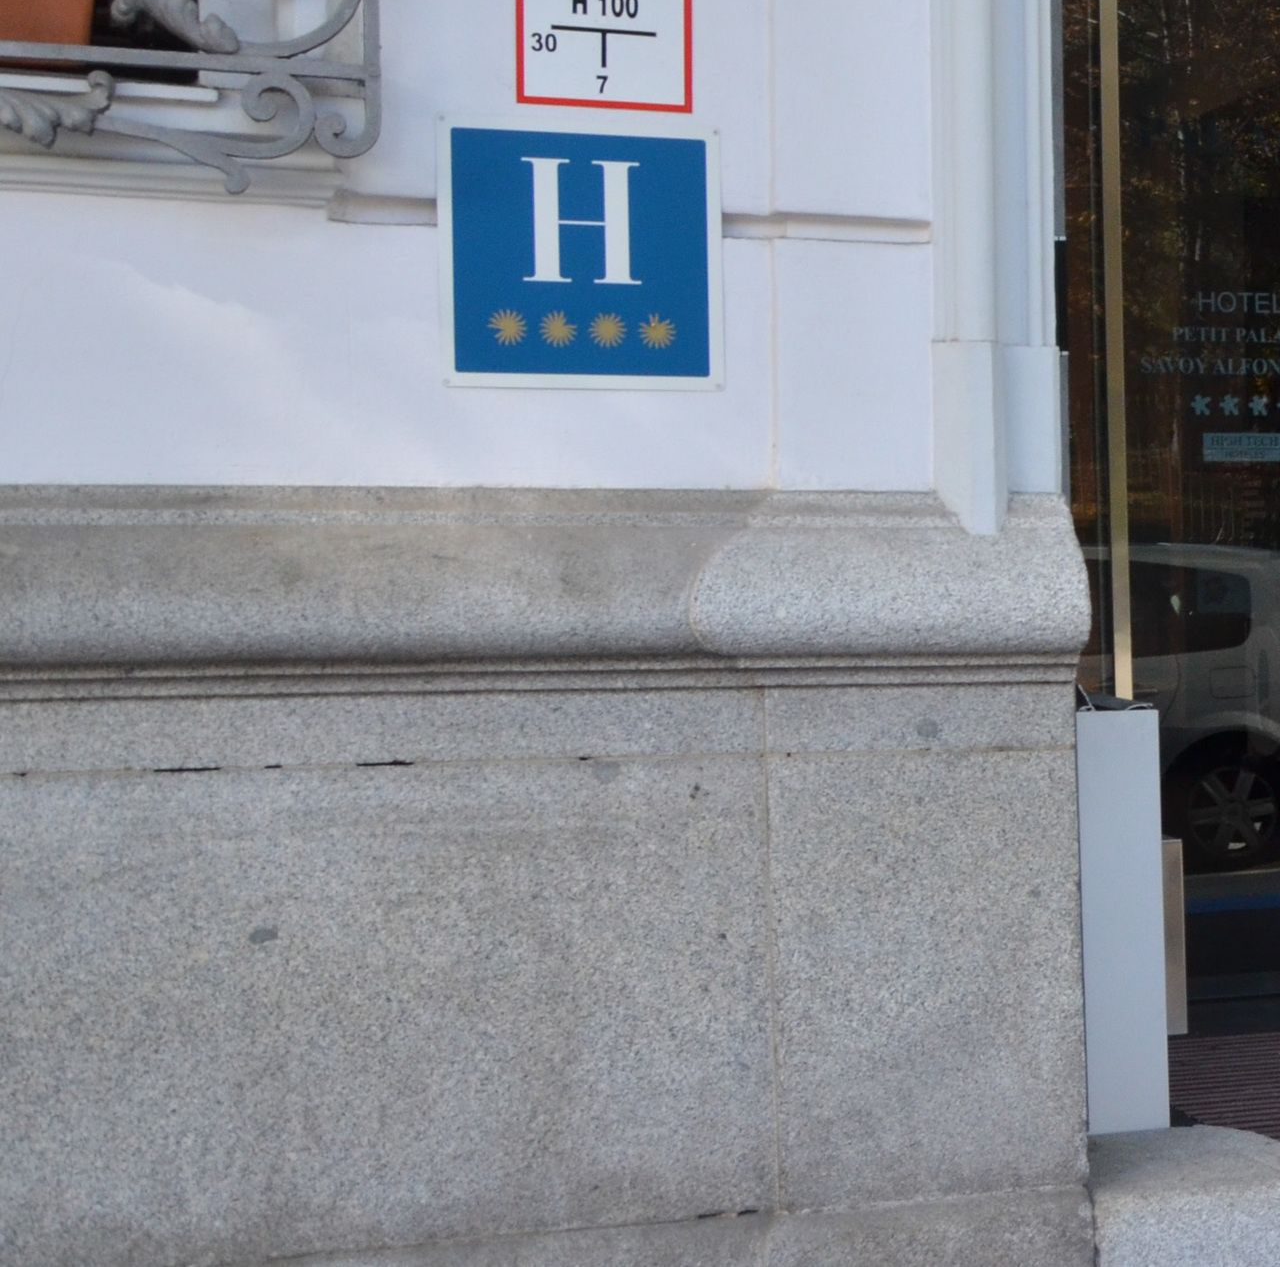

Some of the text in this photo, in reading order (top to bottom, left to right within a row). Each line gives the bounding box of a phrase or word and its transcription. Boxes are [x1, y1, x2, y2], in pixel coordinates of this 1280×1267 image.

[531, 32, 558, 53] 30
[596, 75, 609, 94] 7
[520, 157, 643, 285] H
[1172, 326, 1230, 342] PETIT
[1140, 356, 1209, 375] SAVOY
